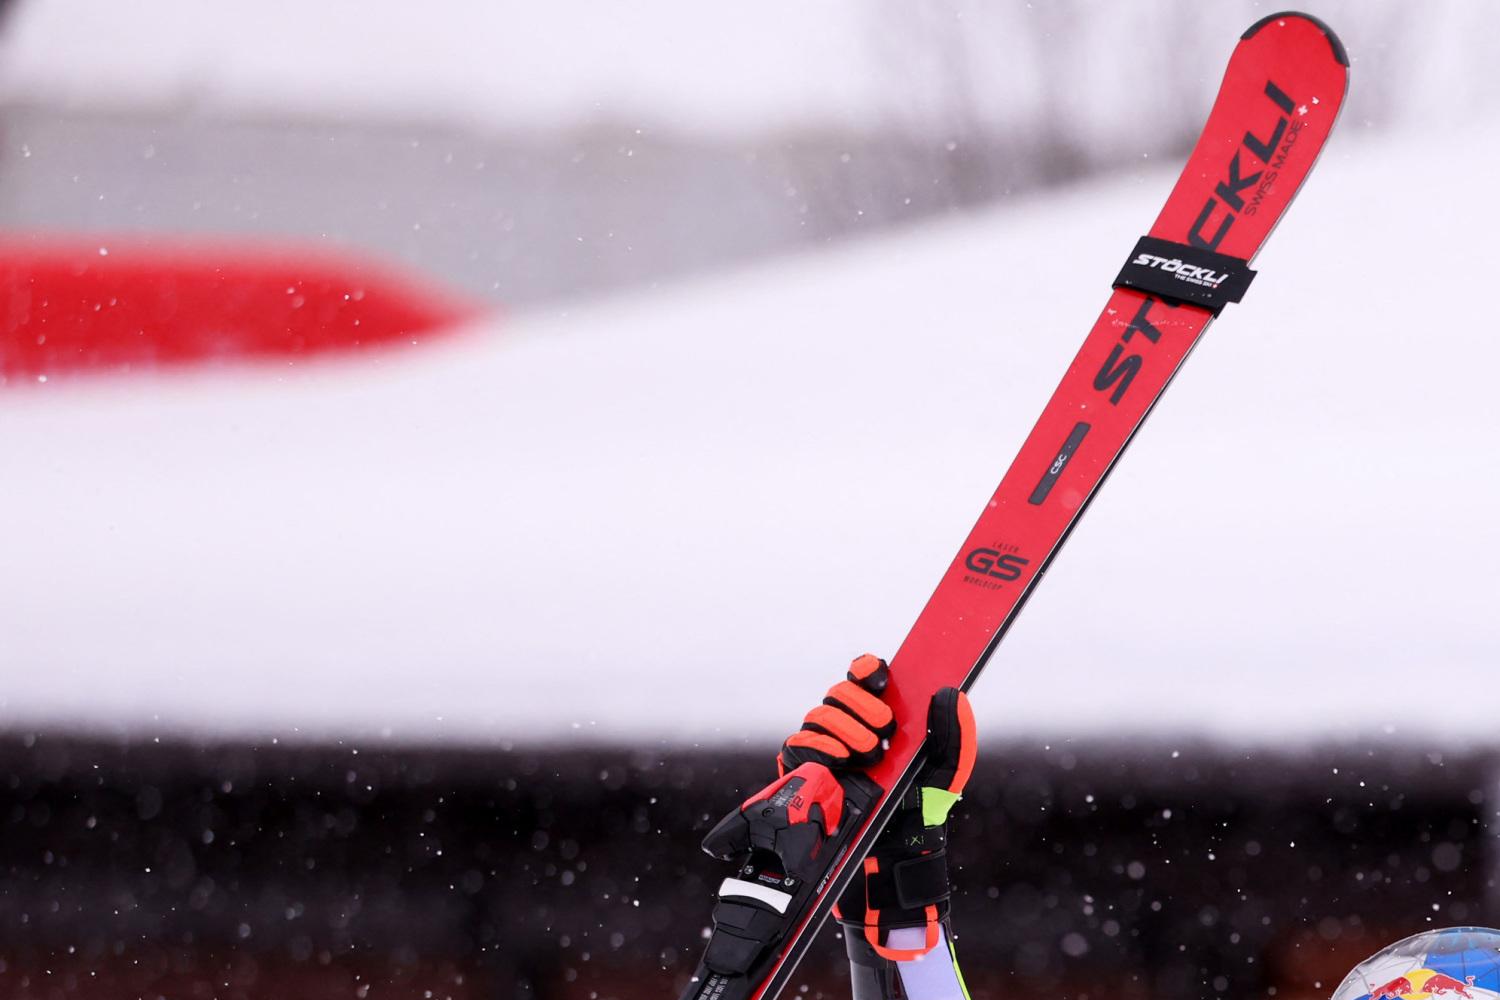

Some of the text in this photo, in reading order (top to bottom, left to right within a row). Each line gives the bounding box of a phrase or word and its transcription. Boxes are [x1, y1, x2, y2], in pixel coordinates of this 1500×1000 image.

[1244, 118, 1304, 216] SWISS MADE
[1132, 253, 1229, 284] STÖCKLI
[965, 548, 1029, 582] GS
